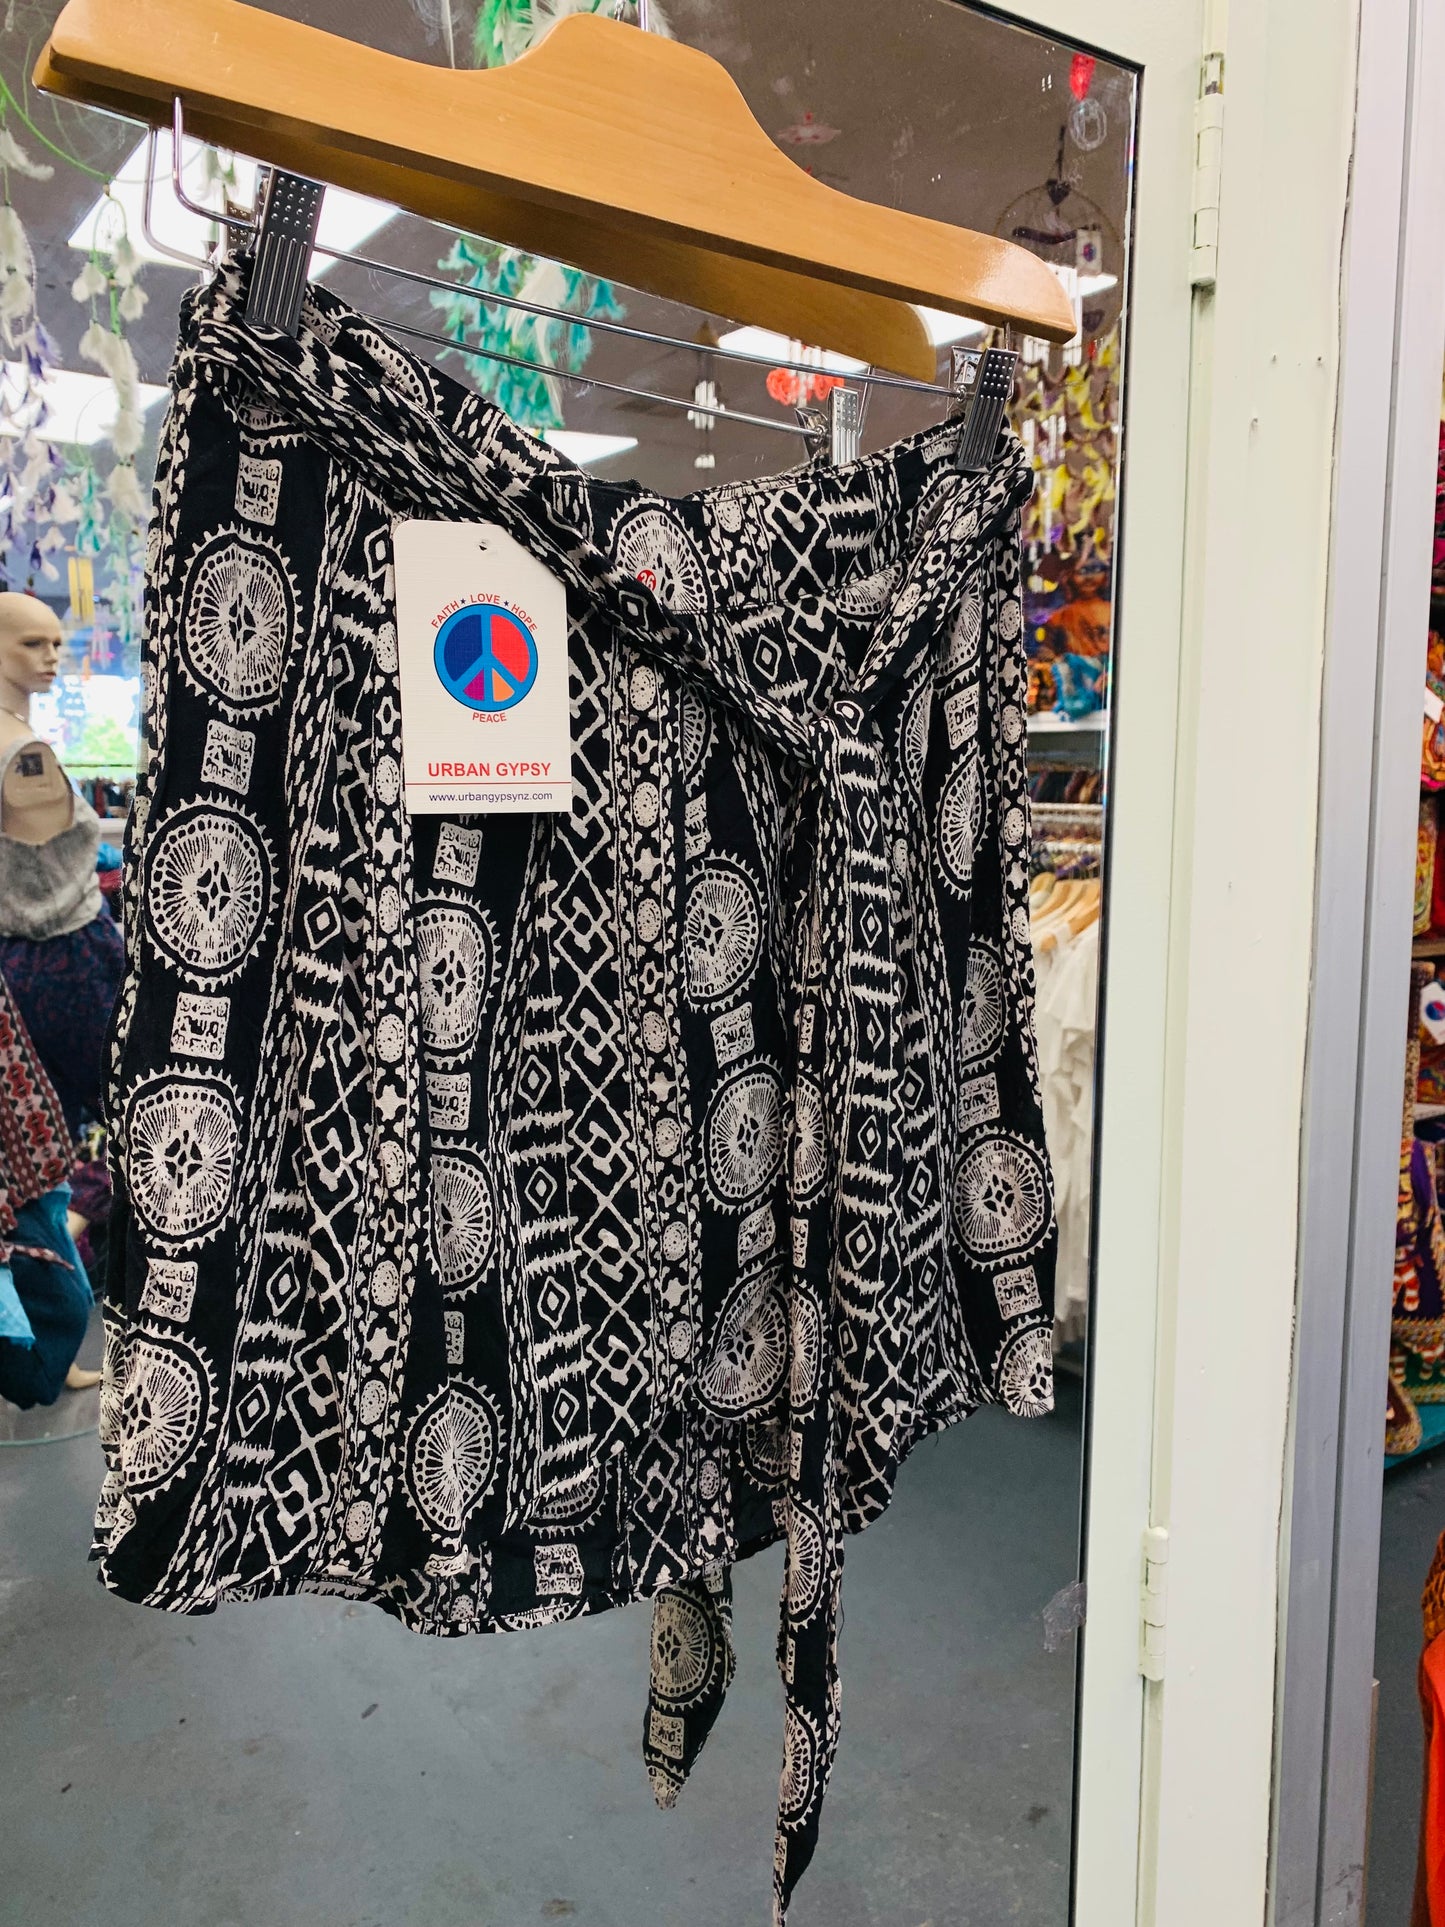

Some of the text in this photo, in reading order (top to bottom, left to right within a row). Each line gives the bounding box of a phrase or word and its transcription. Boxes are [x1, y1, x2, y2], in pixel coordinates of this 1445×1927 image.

[431, 593, 538, 632] FAITH LOVE HOPE
[472, 711, 508, 723] PEACE
[427, 762, 551, 777] URBAN GYPSY
[428, 791, 553, 802] www.urbangypsynz.com
